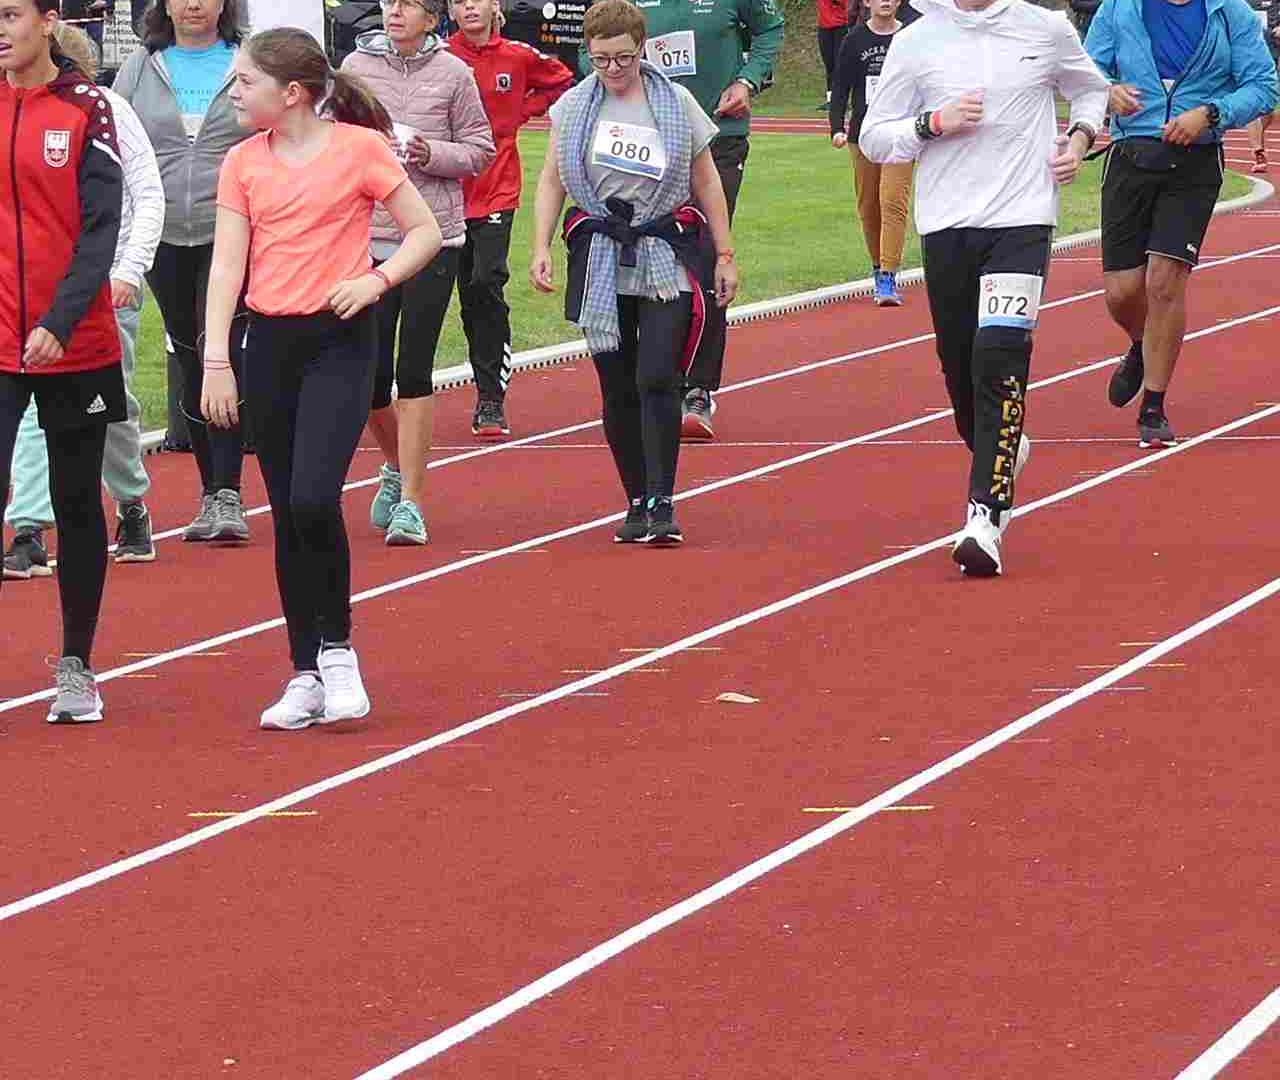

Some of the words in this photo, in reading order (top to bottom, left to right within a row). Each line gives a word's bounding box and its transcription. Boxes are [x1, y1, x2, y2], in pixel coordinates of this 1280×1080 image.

[662, 49, 689, 67] 075
[610, 141, 650, 162] 080
[988, 296, 1028, 316] 072
